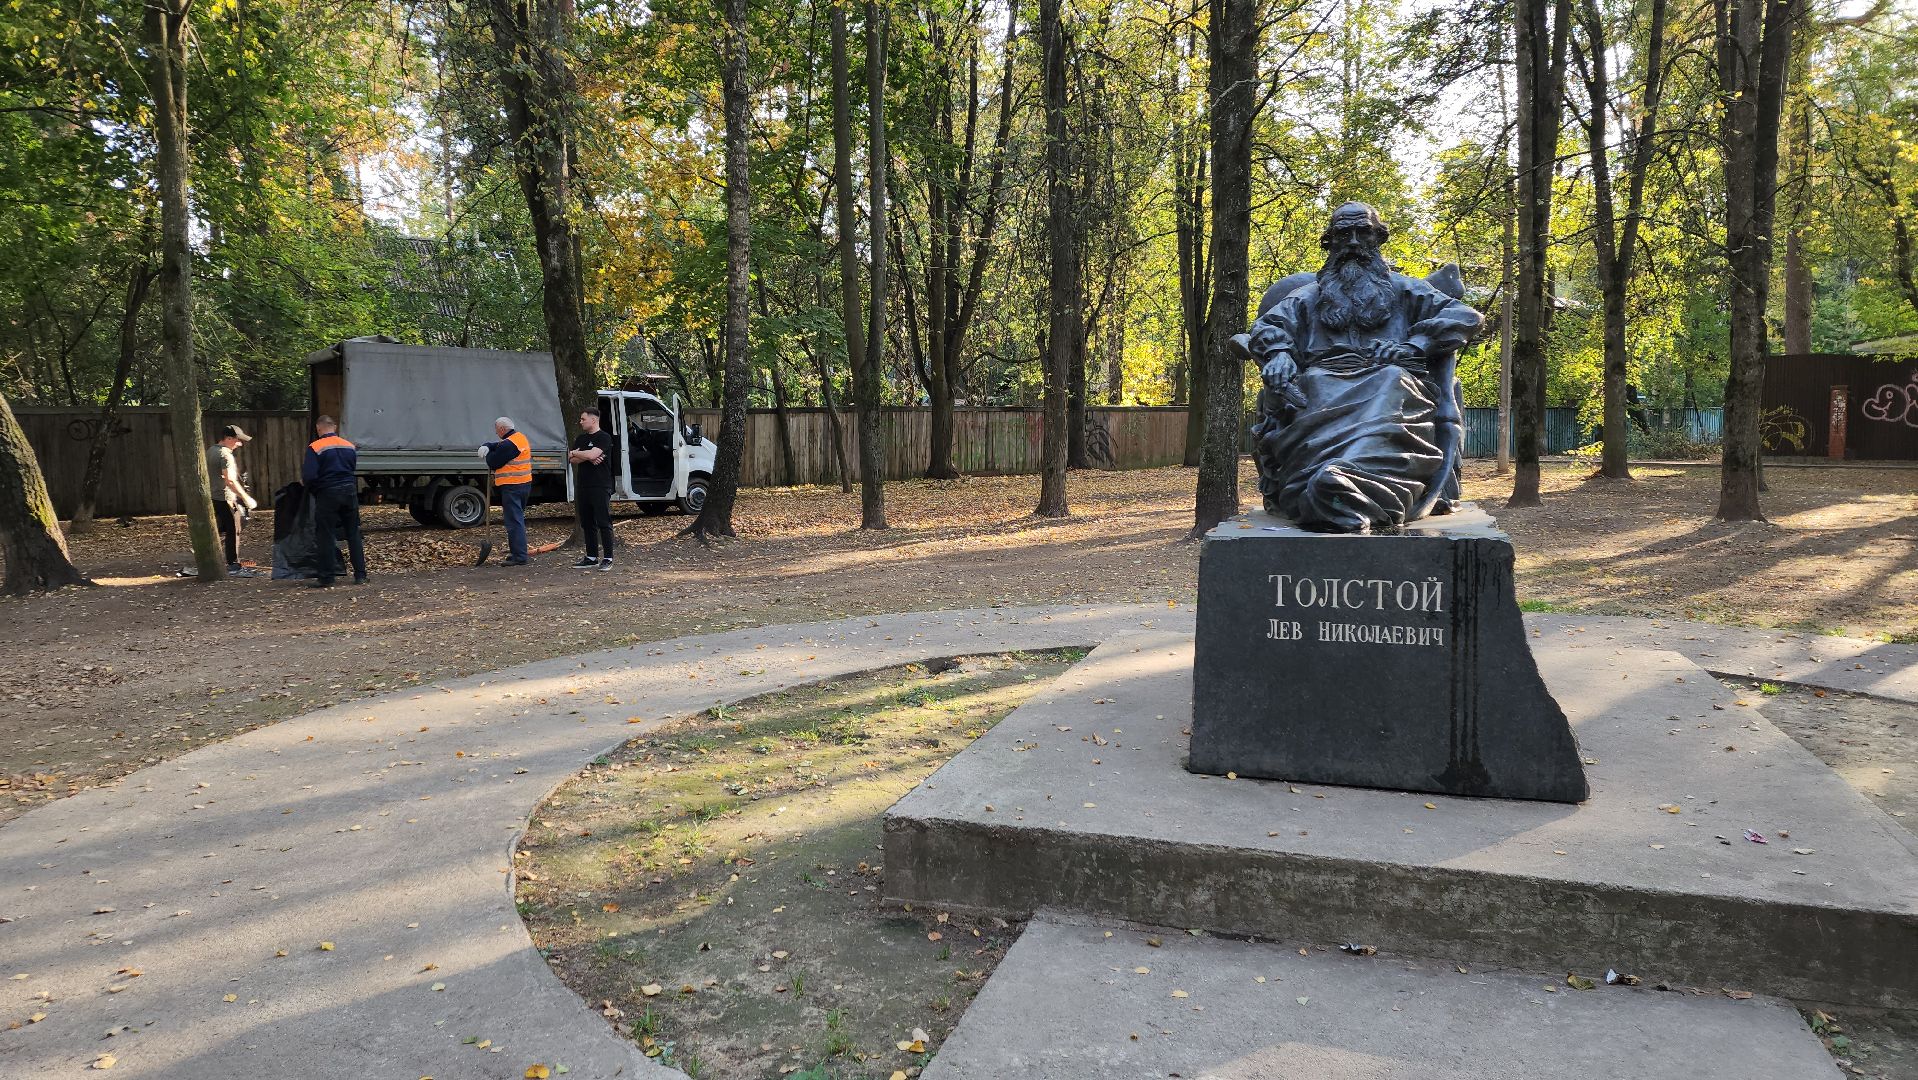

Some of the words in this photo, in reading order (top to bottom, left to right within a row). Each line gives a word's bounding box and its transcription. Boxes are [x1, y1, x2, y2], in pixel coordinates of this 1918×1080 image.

[1267, 574, 1444, 612] ТОЛСТОЙ
[1266, 618, 1303, 640] ЛЕВ
[1318, 620, 1445, 647] НИКОЛАЕВИЧ
